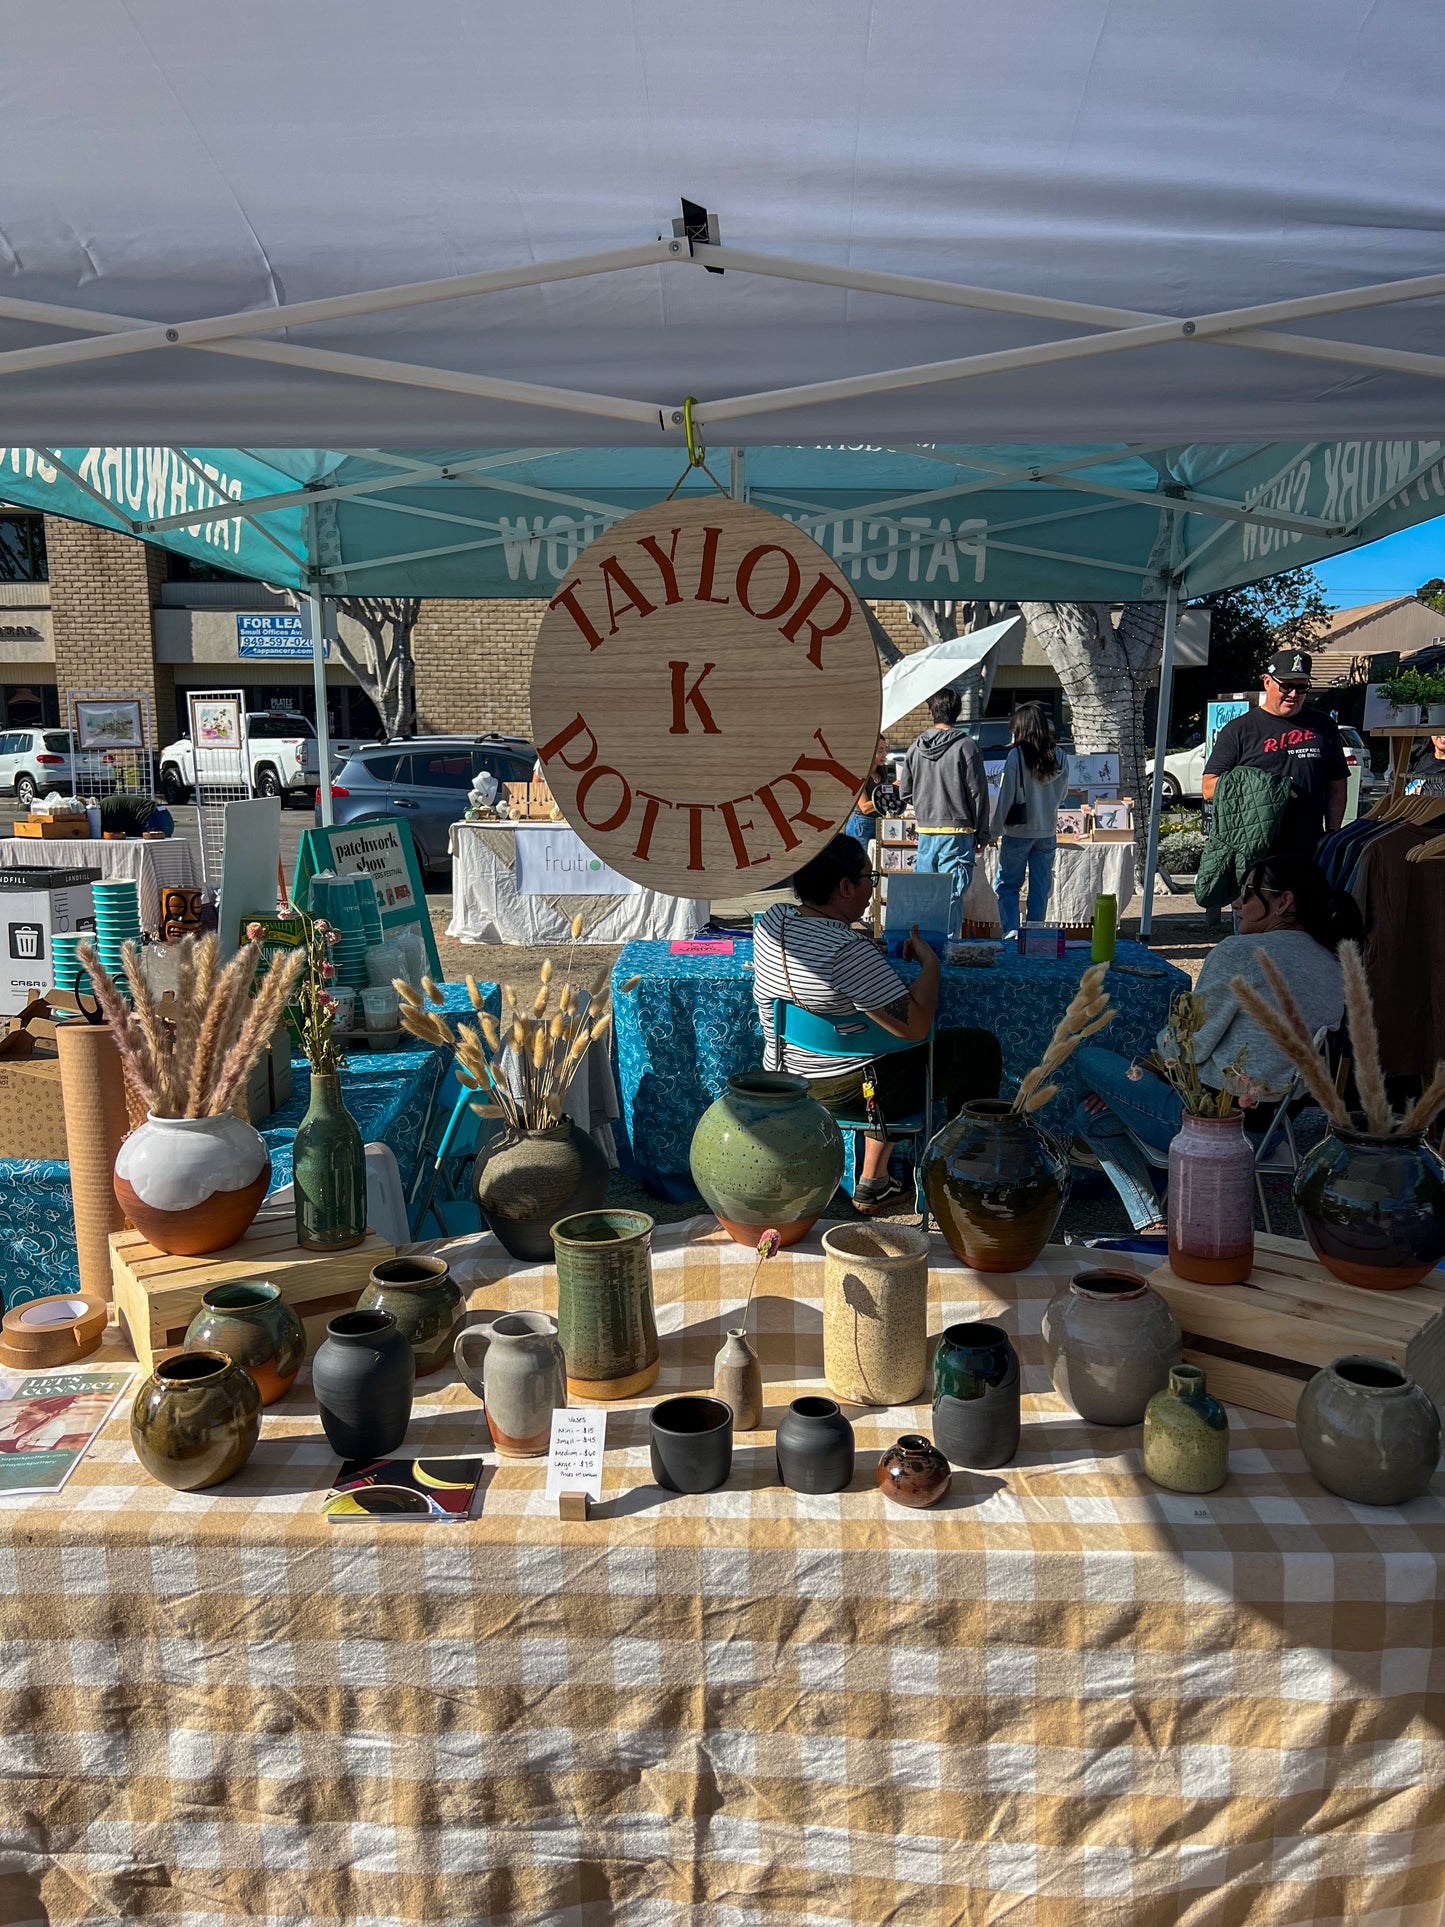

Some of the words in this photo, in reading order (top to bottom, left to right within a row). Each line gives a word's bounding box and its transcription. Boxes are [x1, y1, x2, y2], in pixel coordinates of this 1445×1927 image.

[549, 527, 852, 671] TAYLOR
[243, 618, 271, 628] FOR
[276, 618, 302, 628] LEA
[243, 637, 314, 647] 949-597-020
[668, 660, 722, 735] K
[536, 712, 866, 871] POTTERY
[335, 832, 399, 864] patchwork
[356, 856, 386, 873] show
[65, 873, 90, 882] LANDFILL
[22, 1382, 120, 1396] CONNECT
[28, 1376, 82, 1387] LET'S
